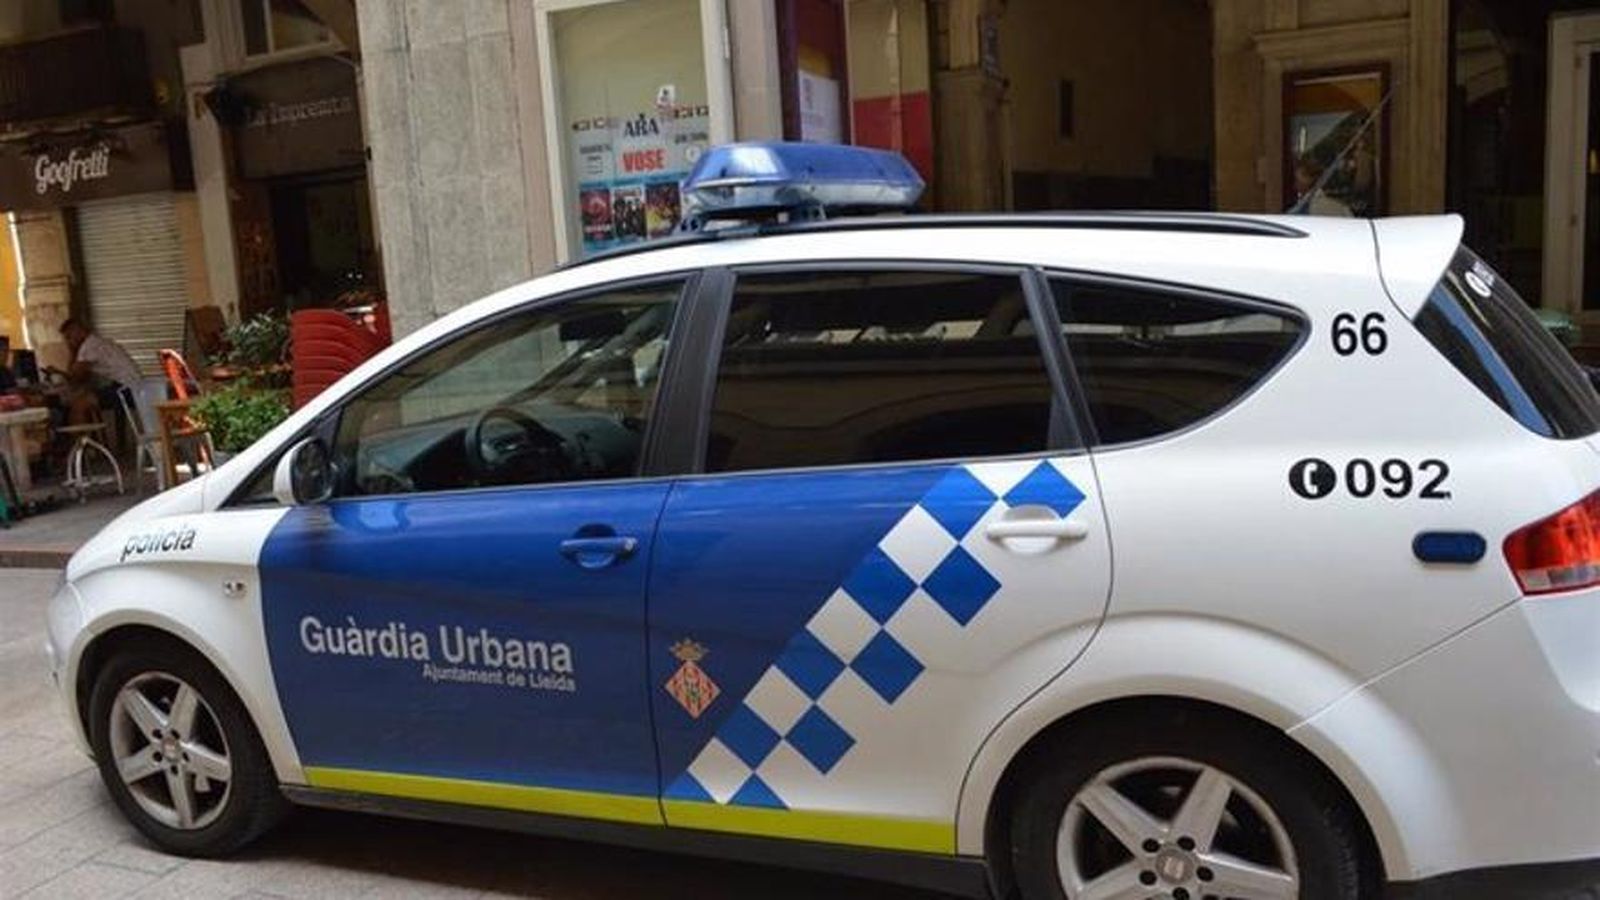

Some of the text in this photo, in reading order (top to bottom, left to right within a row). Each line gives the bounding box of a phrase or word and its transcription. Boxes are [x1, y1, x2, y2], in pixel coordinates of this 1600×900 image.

[624, 117, 660, 138] ARA
[622, 149, 666, 172] VOSE
[1331, 312, 1388, 356] 66
[1345, 458, 1450, 498] 092
[300, 616, 573, 672] Guàrdia Urbana
[422, 664, 576, 691] Ajuntament de Lleida
